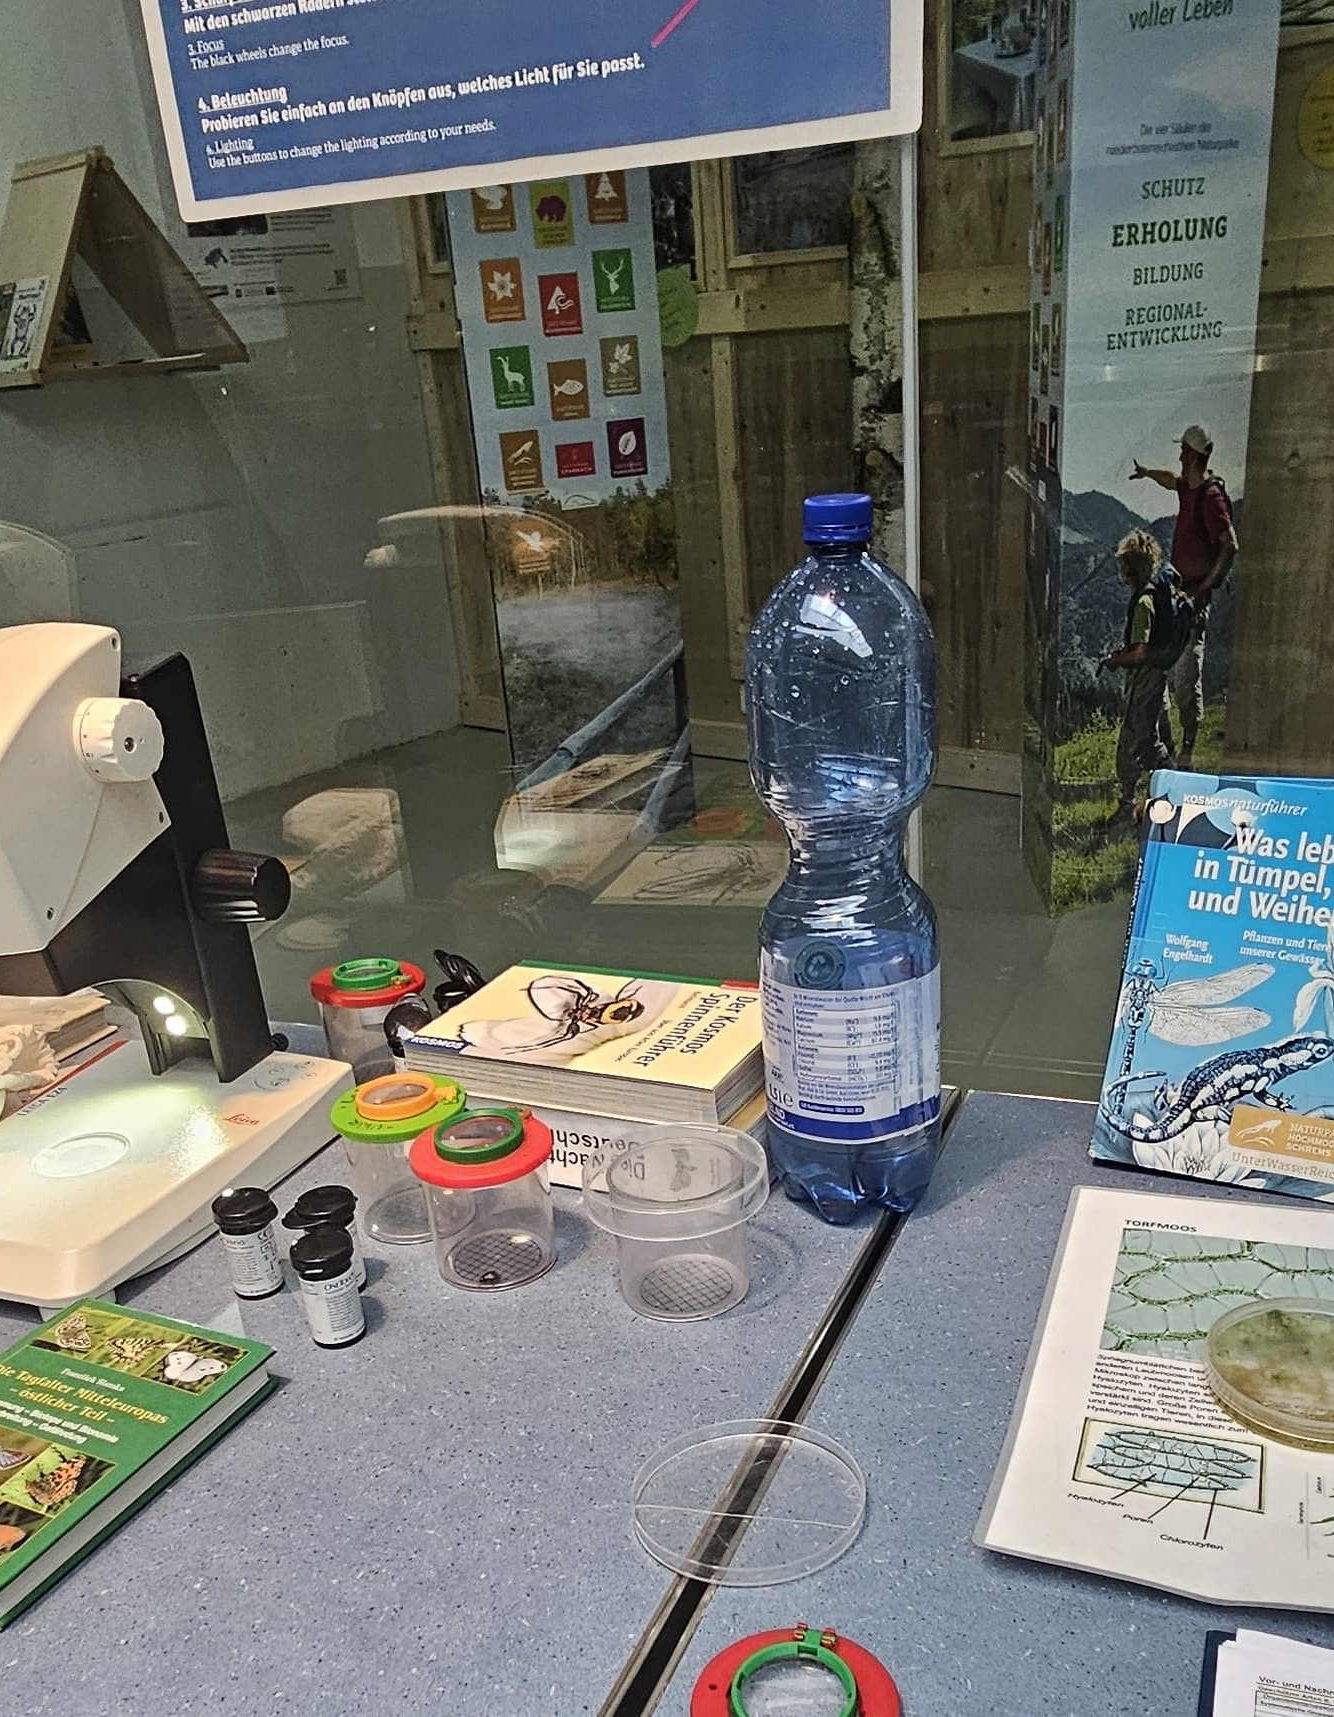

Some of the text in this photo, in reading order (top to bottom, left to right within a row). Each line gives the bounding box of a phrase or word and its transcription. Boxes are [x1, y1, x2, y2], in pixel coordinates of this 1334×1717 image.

[184, 16, 206, 34] Mit
[207, 14, 230, 31] den
[231, 4, 297, 26] schwarzen
[1129, 0, 1178, 30] voller
[188, 38, 224, 56] 3. Focus
[190, 34, 349, 70] The black wheels change the focus.
[198, 86, 288, 111] 4. Beleuchtung
[201, 52, 646, 134] Probieren Sie einfach an den Knöpfen aus, welches Licht für Sie passt.
[208, 118, 497, 169] Use the buttons to change the lighting according to your needs.
[214, 137, 255, 154] Lighting
[1141, 177, 1206, 200] SCHUTZ
[1111, 215, 1228, 248] ERHOLUNG
[1133, 262, 1204, 286] BILDUNG
[1125, 301, 1208, 326] REGIONAL-
[1107, 321, 1224, 351] ENTWICKLUNG
[1235, 827, 1291, 860] Was
[1193, 850, 1220, 881] in
[1227, 854, 1331, 900] Tümpel,
[1188, 887, 1241, 916] und
[1166, 933, 1209, 952] Wolfgang
[1242, 929, 1283, 946] Pflanzen
[1285, 934, 1306, 949] und
[1163, 948, 1213, 965] Engelhardt
[1240, 946, 1325, 967] unserer Gewässer
[725, 996, 759, 1013] Der
[632, 993, 731, 1068] Spinnenführer
[679, 1015, 740, 1055] Kosmos
[410, 1036, 465, 1050] KOSMOS
[223, 1112, 262, 1127] Leica
[551, 1128, 641, 1151] Deutschl
[1285, 1143, 1332, 1158] SCHREMS
[549, 1148, 605, 1169] Nacht
[1123, 1218, 1198, 1233] TORFMOOS
[1094, 1368, 1141, 1380] Mikroskop
[1096, 1361, 1194, 1381] anderen Laubmoosen
[16, 1370, 75, 1395] Tagfalter
[73, 1387, 170, 1424] Mitteleuropas
[18, 1389, 107, 1423] östlicher Teil
[1158, 1391, 1187, 1402] deren
[1087, 1397, 1107, 1406] und
[1196, 1413, 1206, 1421] in
[1141, 1412, 1172, 1424] tragen
[1189, 1404, 1218, 1415] Poren
[1122, 1513, 1155, 1525] Poren
[1259, 1675, 1280, 1685] Vor-
[1282, 1681, 1301, 1690] und
